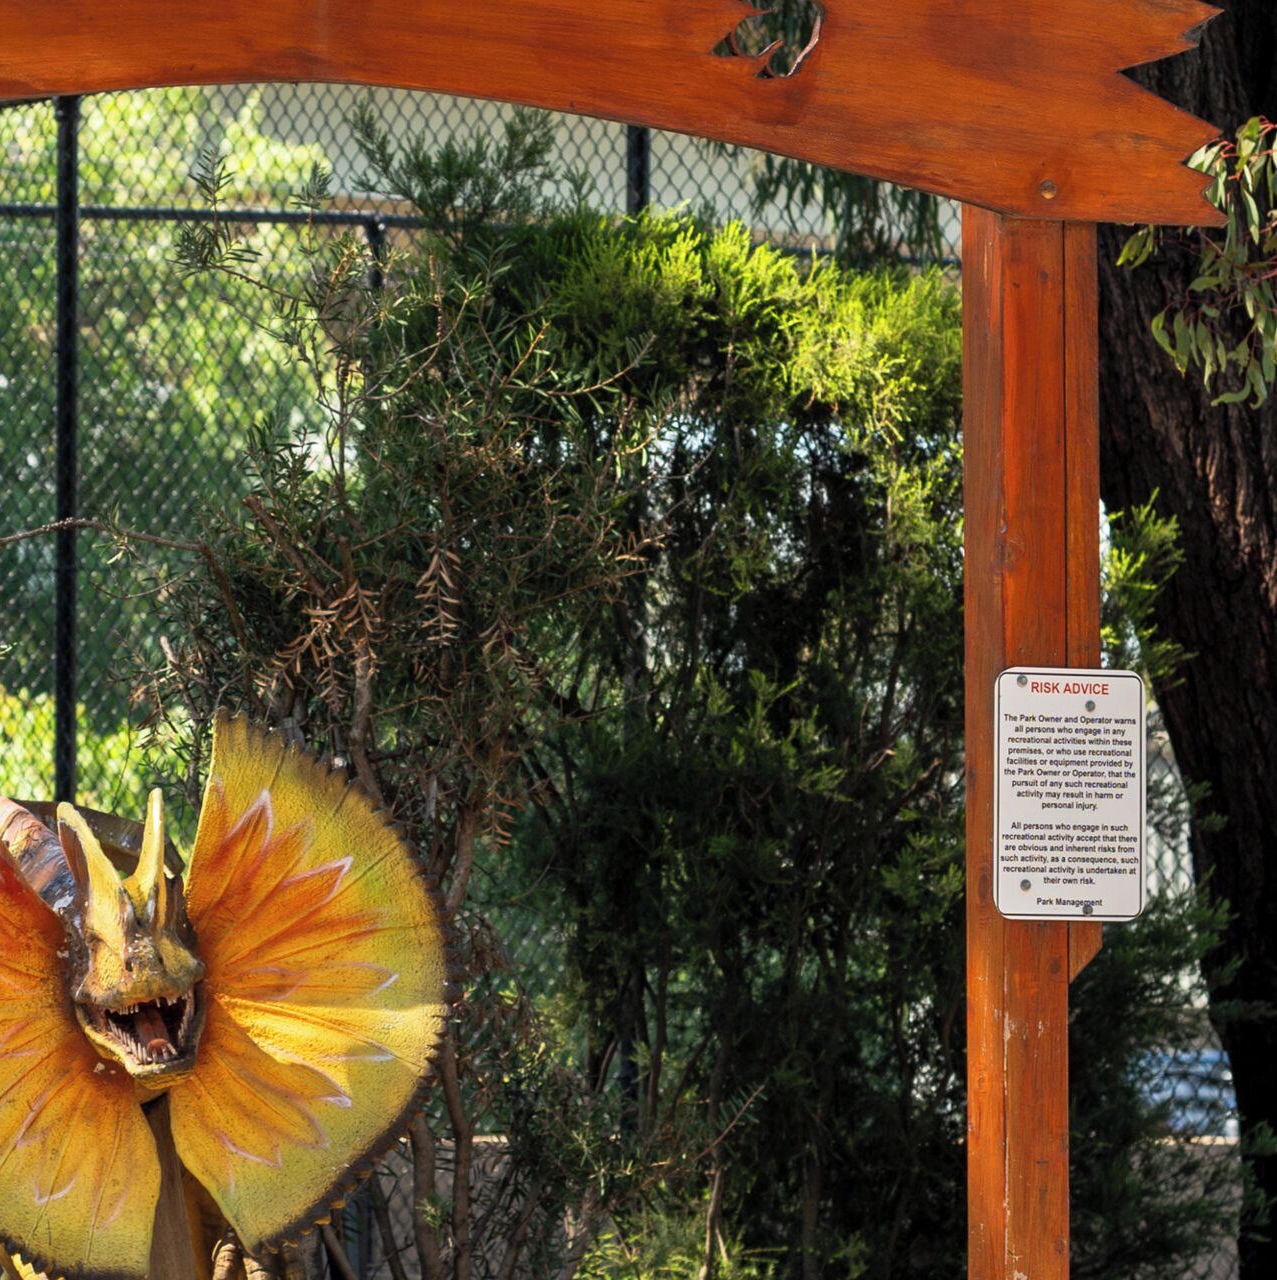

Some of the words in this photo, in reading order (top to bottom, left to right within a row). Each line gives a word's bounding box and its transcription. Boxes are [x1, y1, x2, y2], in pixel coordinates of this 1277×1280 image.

[1031, 682, 1060, 694] RISK
[1064, 683, 1109, 695] ADVICE
[1080, 716, 1112, 724] Operator
[1074, 728, 1101, 736] engage
[1008, 736, 1051, 744] recreational
[1008, 747, 1044, 755] premises,
[1049, 759, 1088, 767] equipment
[1090, 760, 1122, 768] provided
[1124, 760, 1133, 769] by
[1072, 770, 1106, 778] Operator,
[1050, 781, 1062, 789] any
[1016, 790, 1043, 798] activity
[1042, 802, 1074, 810] personal
[1076, 802, 1098, 811] injury.
[1073, 824, 1100, 832] engage
[1048, 834, 1074, 842] activity
[1020, 856, 1049, 864] activity,
[1068, 857, 1119, 865] consequence,
[1049, 866, 1075, 874] activity
[1056, 898, 1102, 907] Management
